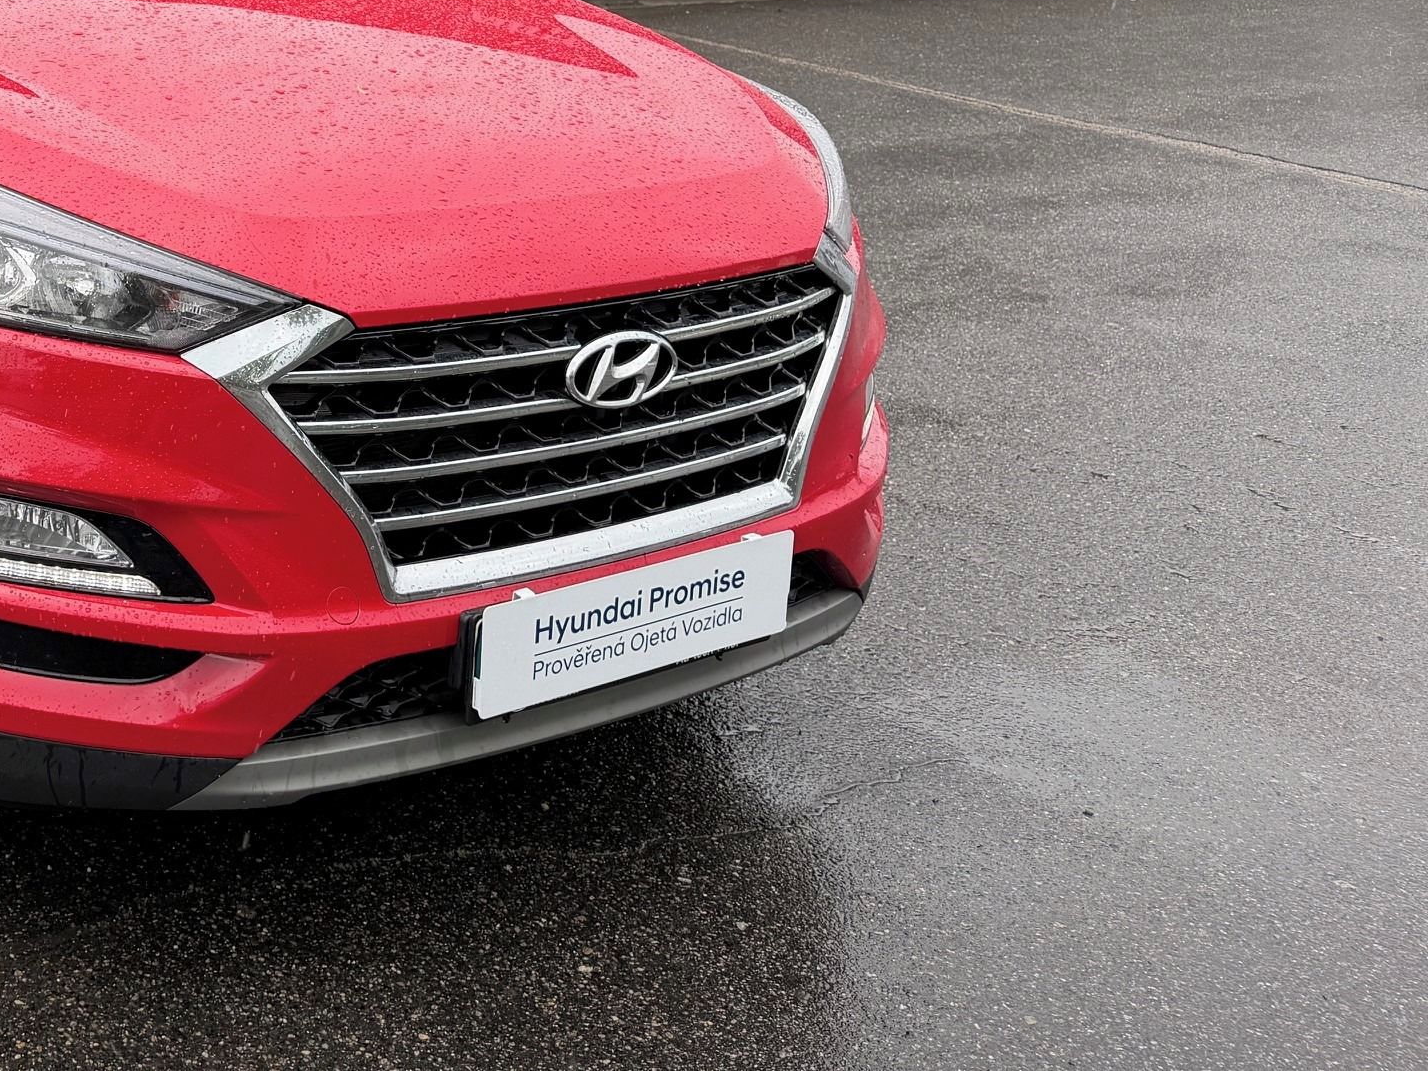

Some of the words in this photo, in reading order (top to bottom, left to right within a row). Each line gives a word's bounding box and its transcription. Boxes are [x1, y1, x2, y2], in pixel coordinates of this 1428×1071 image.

[532, 635, 625, 680] Prověřená
[631, 623, 677, 654] Ojetá
[682, 606, 743, 636] Vozidla
[534, 589, 643, 644] Hyundai
[649, 569, 745, 613] Promise
